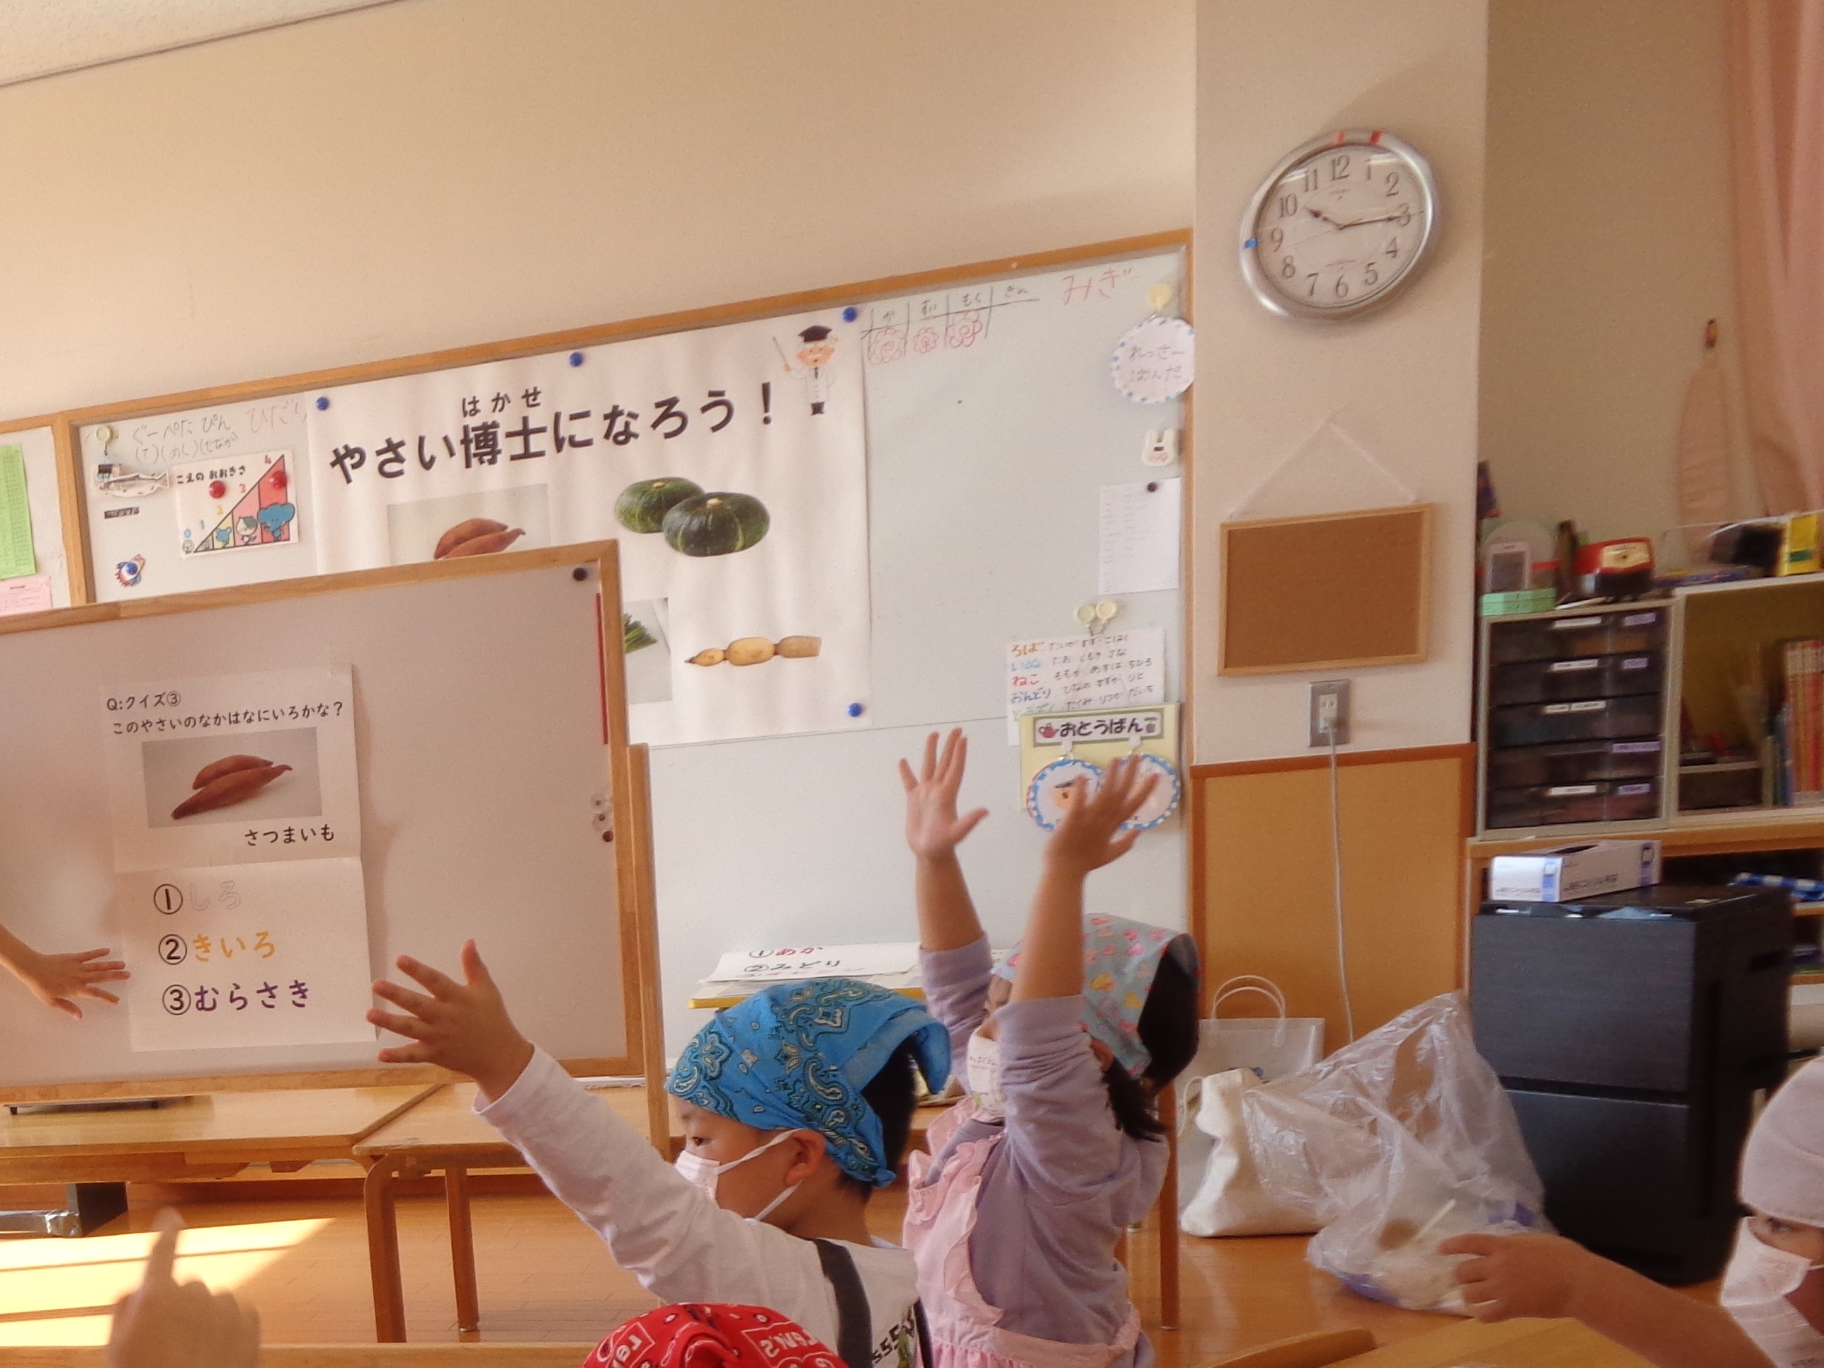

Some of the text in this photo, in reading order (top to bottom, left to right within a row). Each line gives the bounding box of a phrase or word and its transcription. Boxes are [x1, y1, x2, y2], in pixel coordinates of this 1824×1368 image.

[1304, 168, 1318, 192] 11
[1330, 155, 1350, 182] 12
[1385, 172, 1399, 197] 2
[1279, 193, 1298, 219] 10
[1270, 227, 1284, 252] 9
[1385, 237, 1399, 259] 4
[1282, 255, 1296, 279] 8
[1364, 262, 1378, 285] 5
[1062, 268, 1133, 305] みぎ
[1306, 272, 1320, 296] 7
[1335, 274, 1349, 298] 6
[462, 386, 542, 418] はかせ
[1060, 717, 1143, 738] おとうばん
[244, 824, 335, 846] さつまいも
